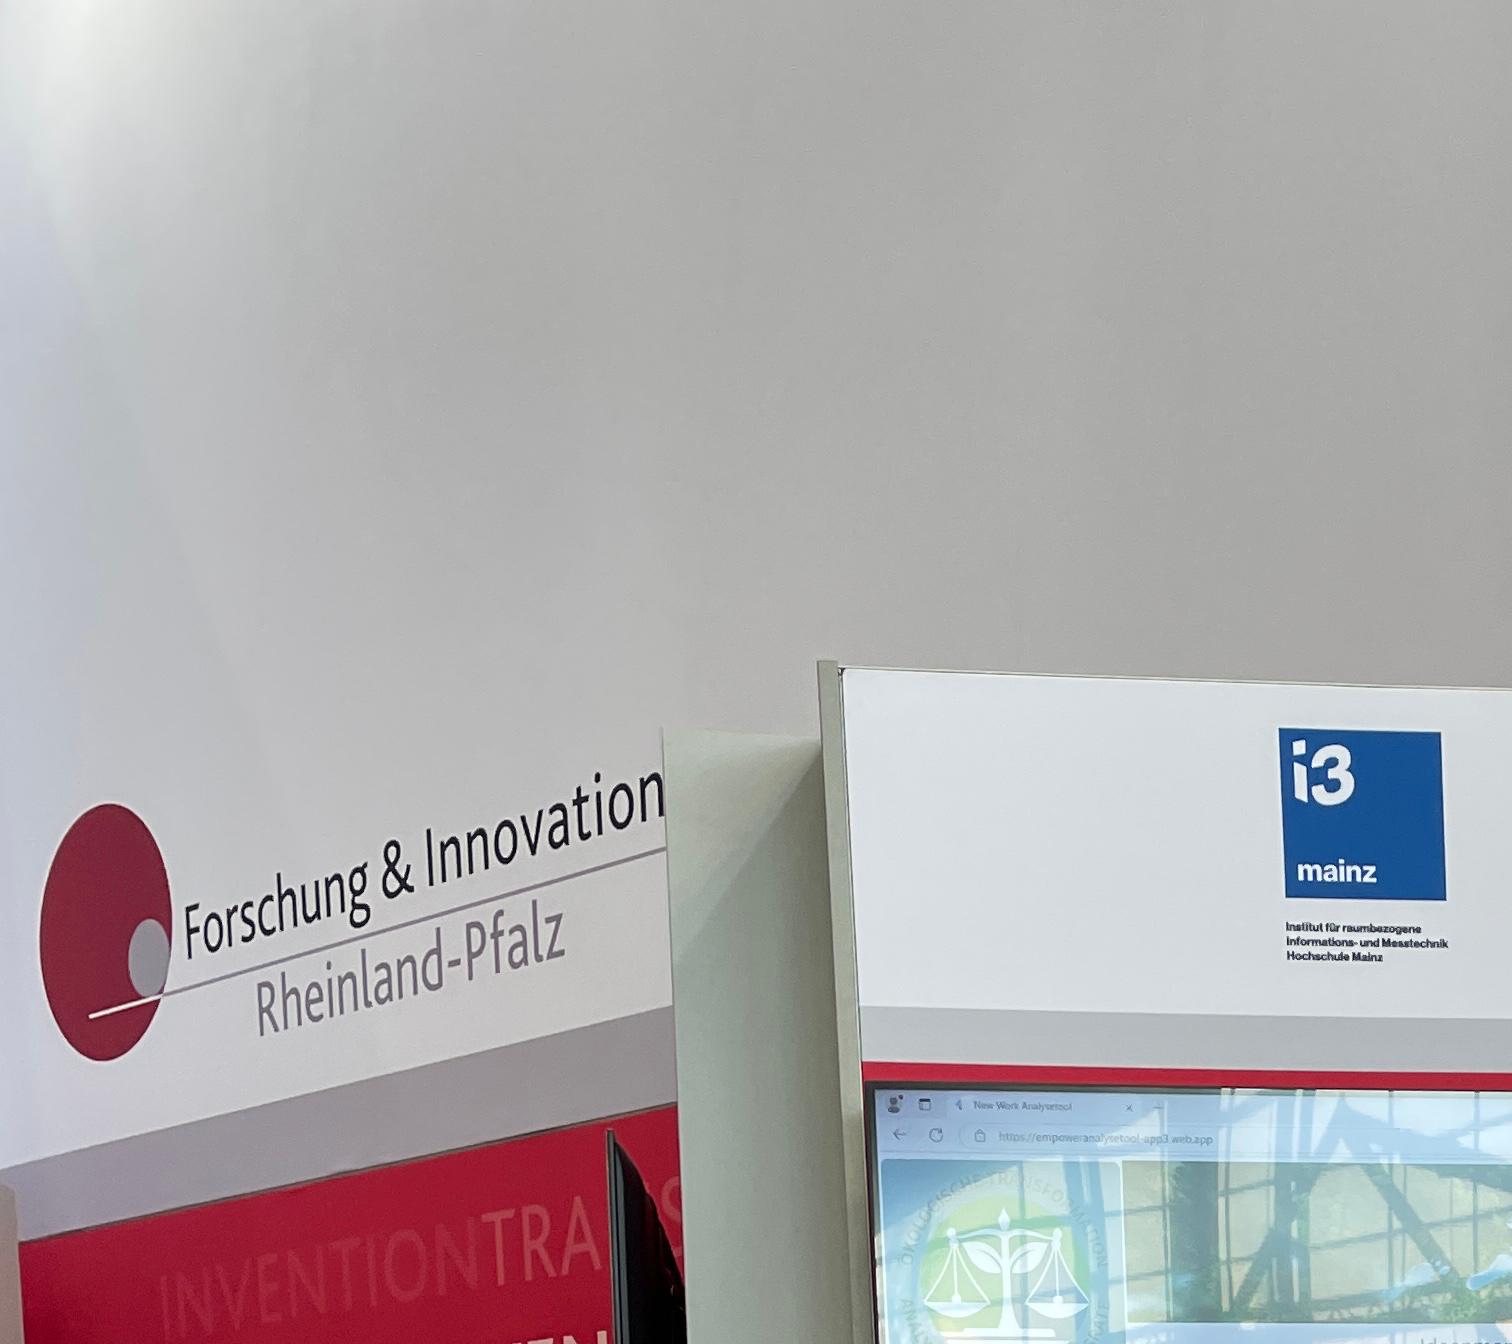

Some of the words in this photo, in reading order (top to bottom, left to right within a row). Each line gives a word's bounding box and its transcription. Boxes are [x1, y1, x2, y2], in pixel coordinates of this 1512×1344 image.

[1292, 739, 1355, 806] i3
[184, 859, 368, 960] Forschung
[381, 838, 414, 898] &
[425, 770, 665, 886] Innovation
[1297, 859, 1378, 883] mainz
[1286, 921, 1323, 933] Institut
[1325, 922, 1340, 933] für
[1342, 923, 1422, 935] raumbezogene
[1286, 937, 1358, 948] Informations-
[1359, 937, 1380, 948] und
[1382, 937, 1449, 949] Messtechnik
[256, 900, 566, 1037] Rheinland-Pfalz
[1286, 951, 1350, 962] Hochschule
[1352, 952, 1384, 962] Mainz
